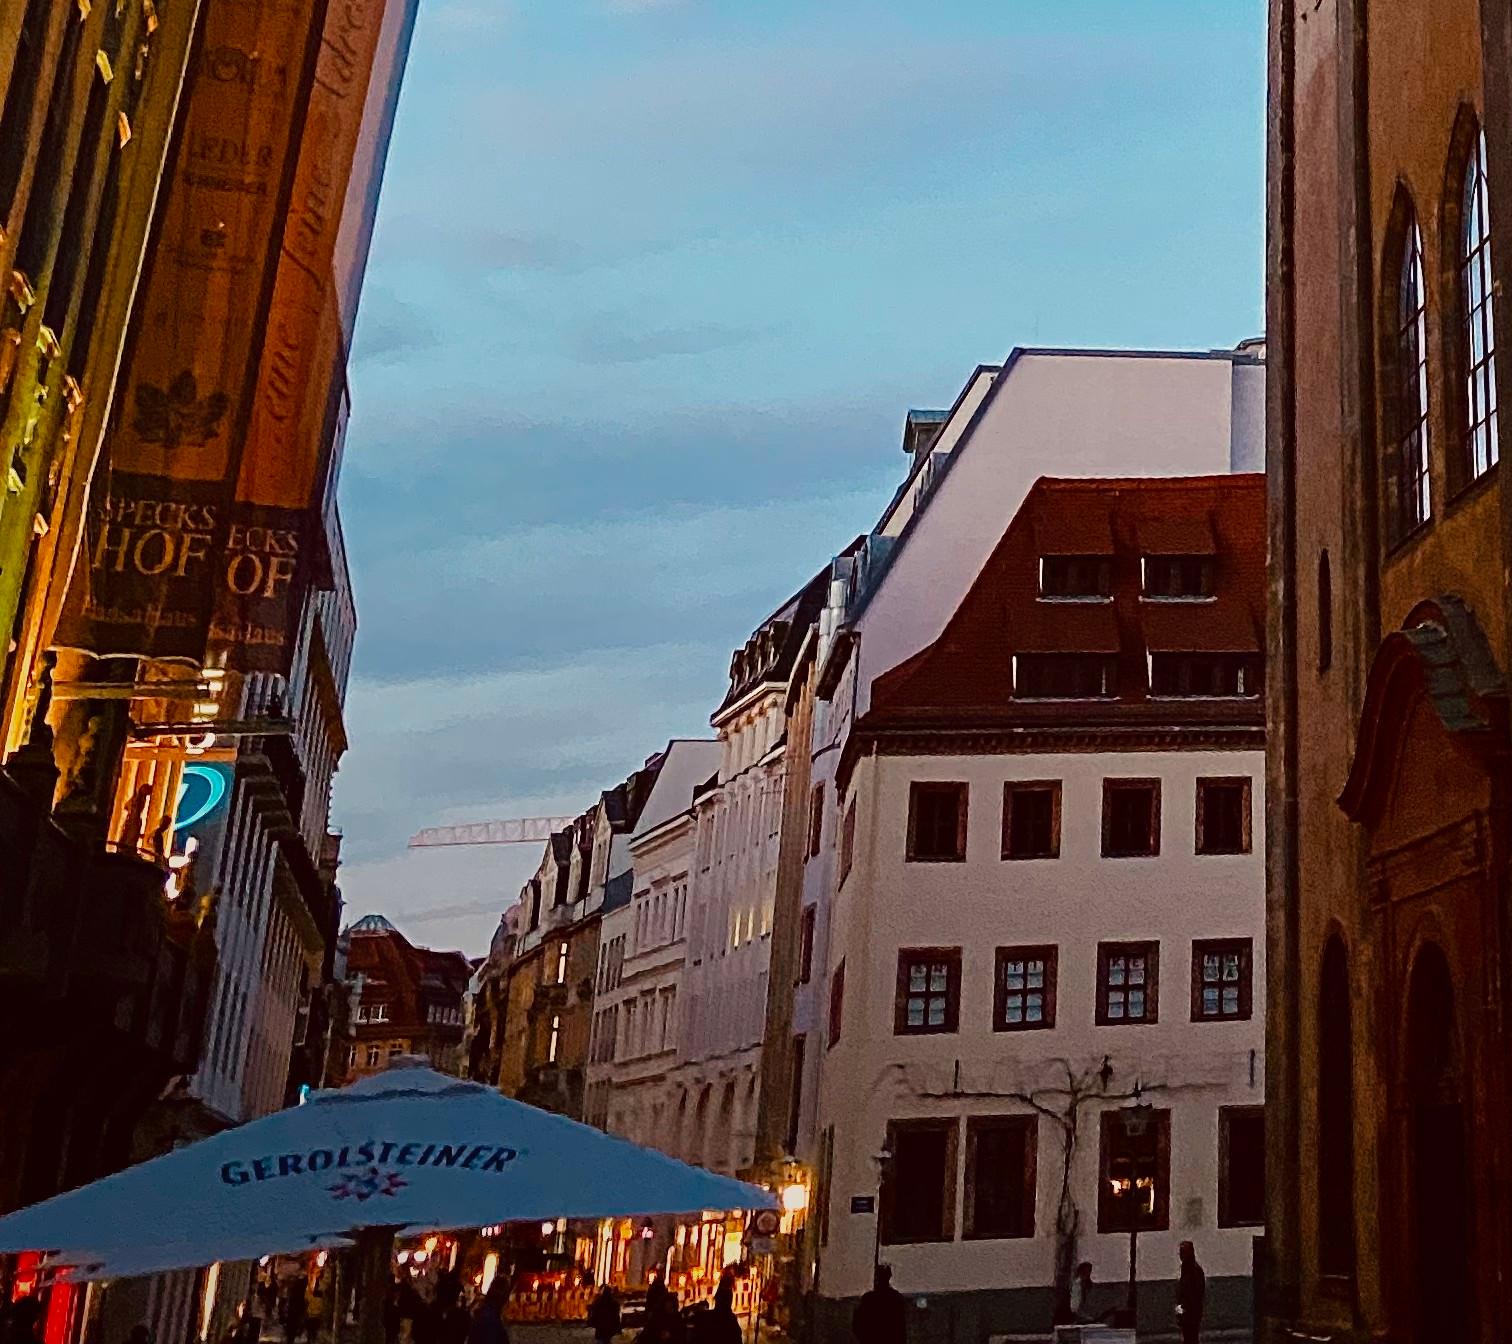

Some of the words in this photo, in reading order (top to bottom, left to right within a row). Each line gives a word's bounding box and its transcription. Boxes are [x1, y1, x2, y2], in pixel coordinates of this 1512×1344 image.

[92, 523, 212, 576] HOF
[226, 524, 300, 555] ECKS
[227, 553, 298, 599] OF
[221, 1139, 517, 1187] GEROLSTEINER
